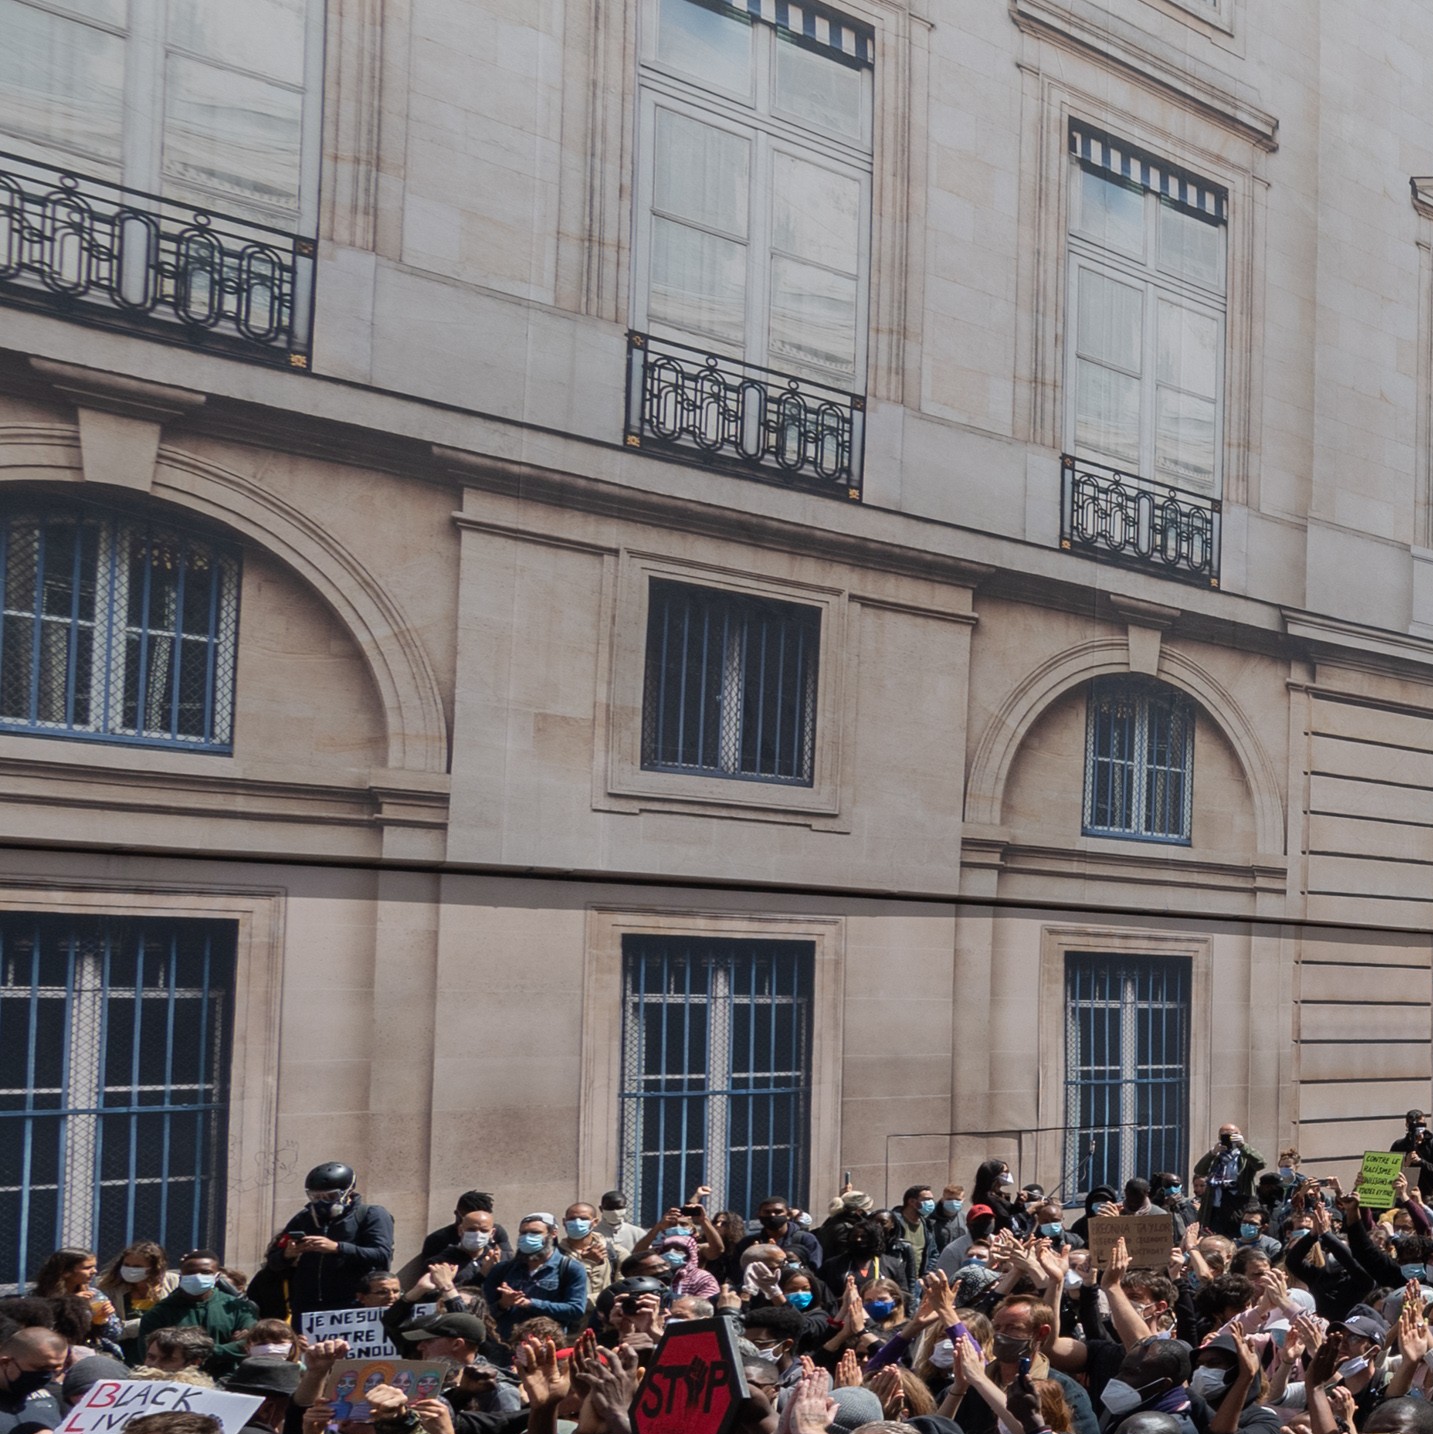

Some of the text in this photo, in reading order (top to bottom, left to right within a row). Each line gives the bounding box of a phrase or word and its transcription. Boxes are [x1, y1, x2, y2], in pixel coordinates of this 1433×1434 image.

[1366, 1154, 1389, 1166] CONTRE
[330, 1311, 354, 1326] NE
[86, 1383, 204, 1412] BLACK
